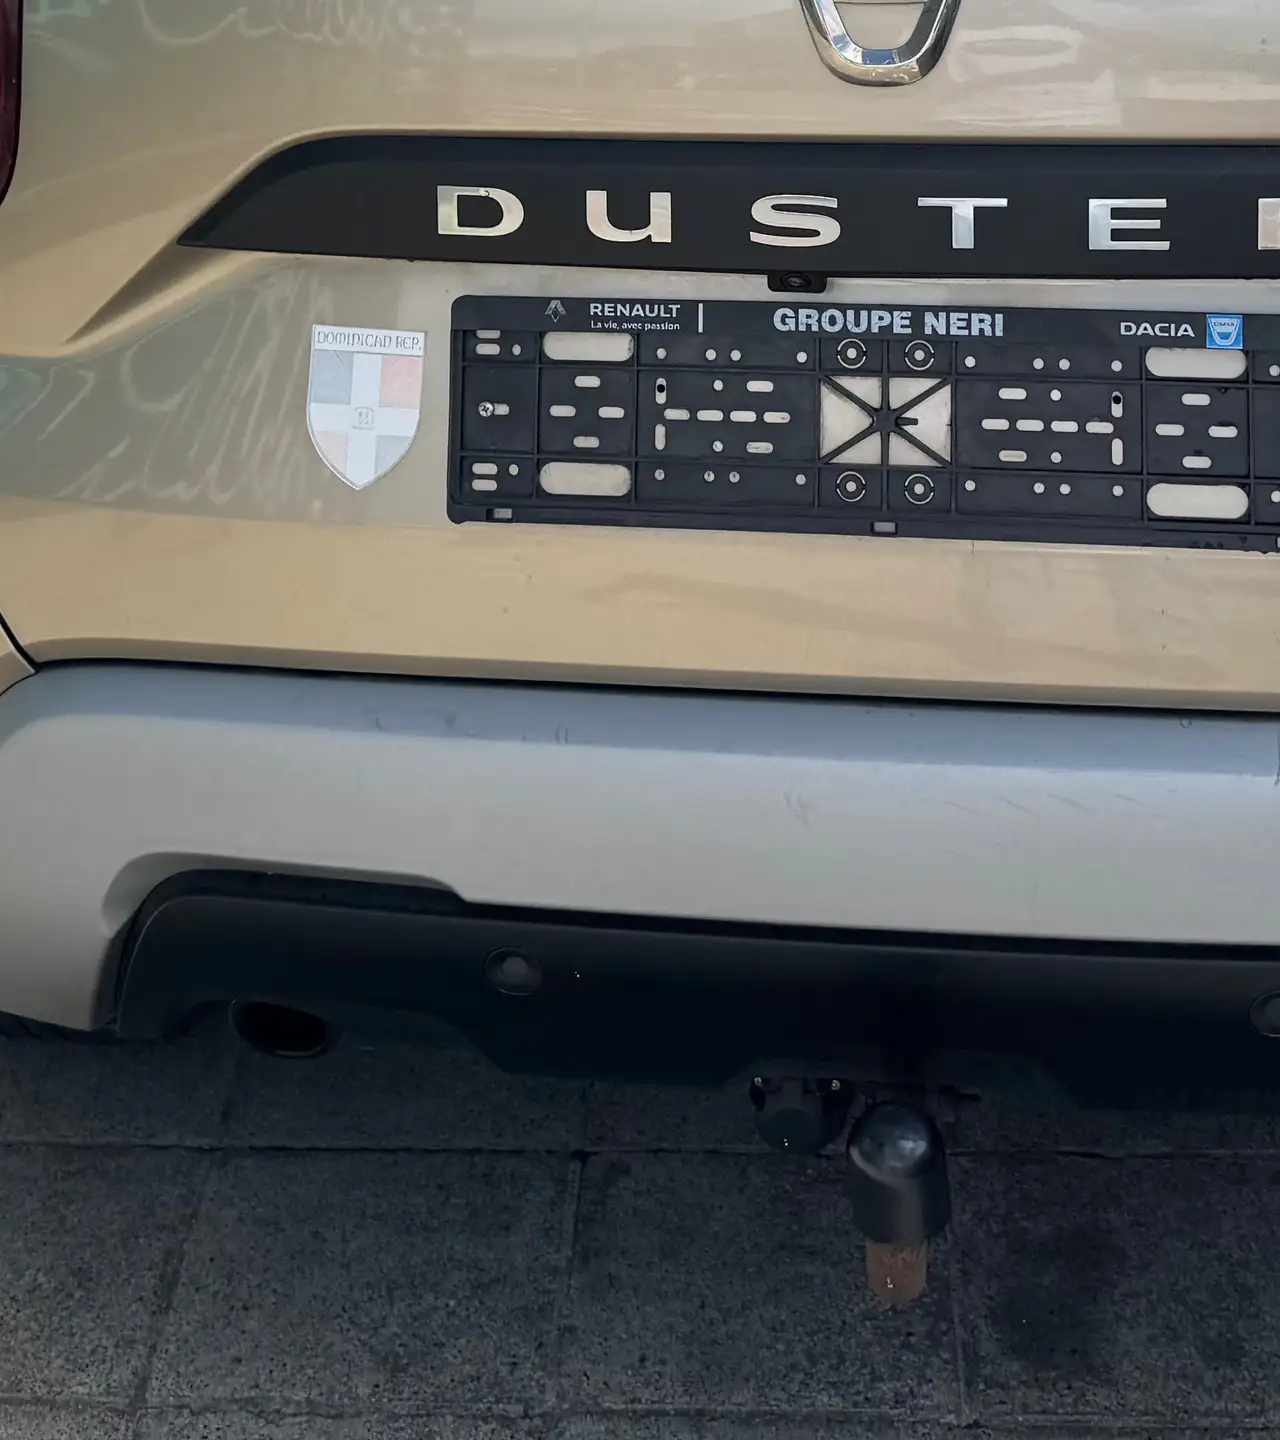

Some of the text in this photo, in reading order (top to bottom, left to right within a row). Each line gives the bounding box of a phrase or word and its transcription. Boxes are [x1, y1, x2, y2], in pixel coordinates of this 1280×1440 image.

[590, 303, 680, 318] RENAULT
[591, 320, 602, 329] La
[644, 322, 680, 331] passion
[773, 308, 1004, 337] GROUPE NERI
[1120, 322, 1195, 337] DACIA
[317, 331, 422, 351] DOMINICAN REP.
